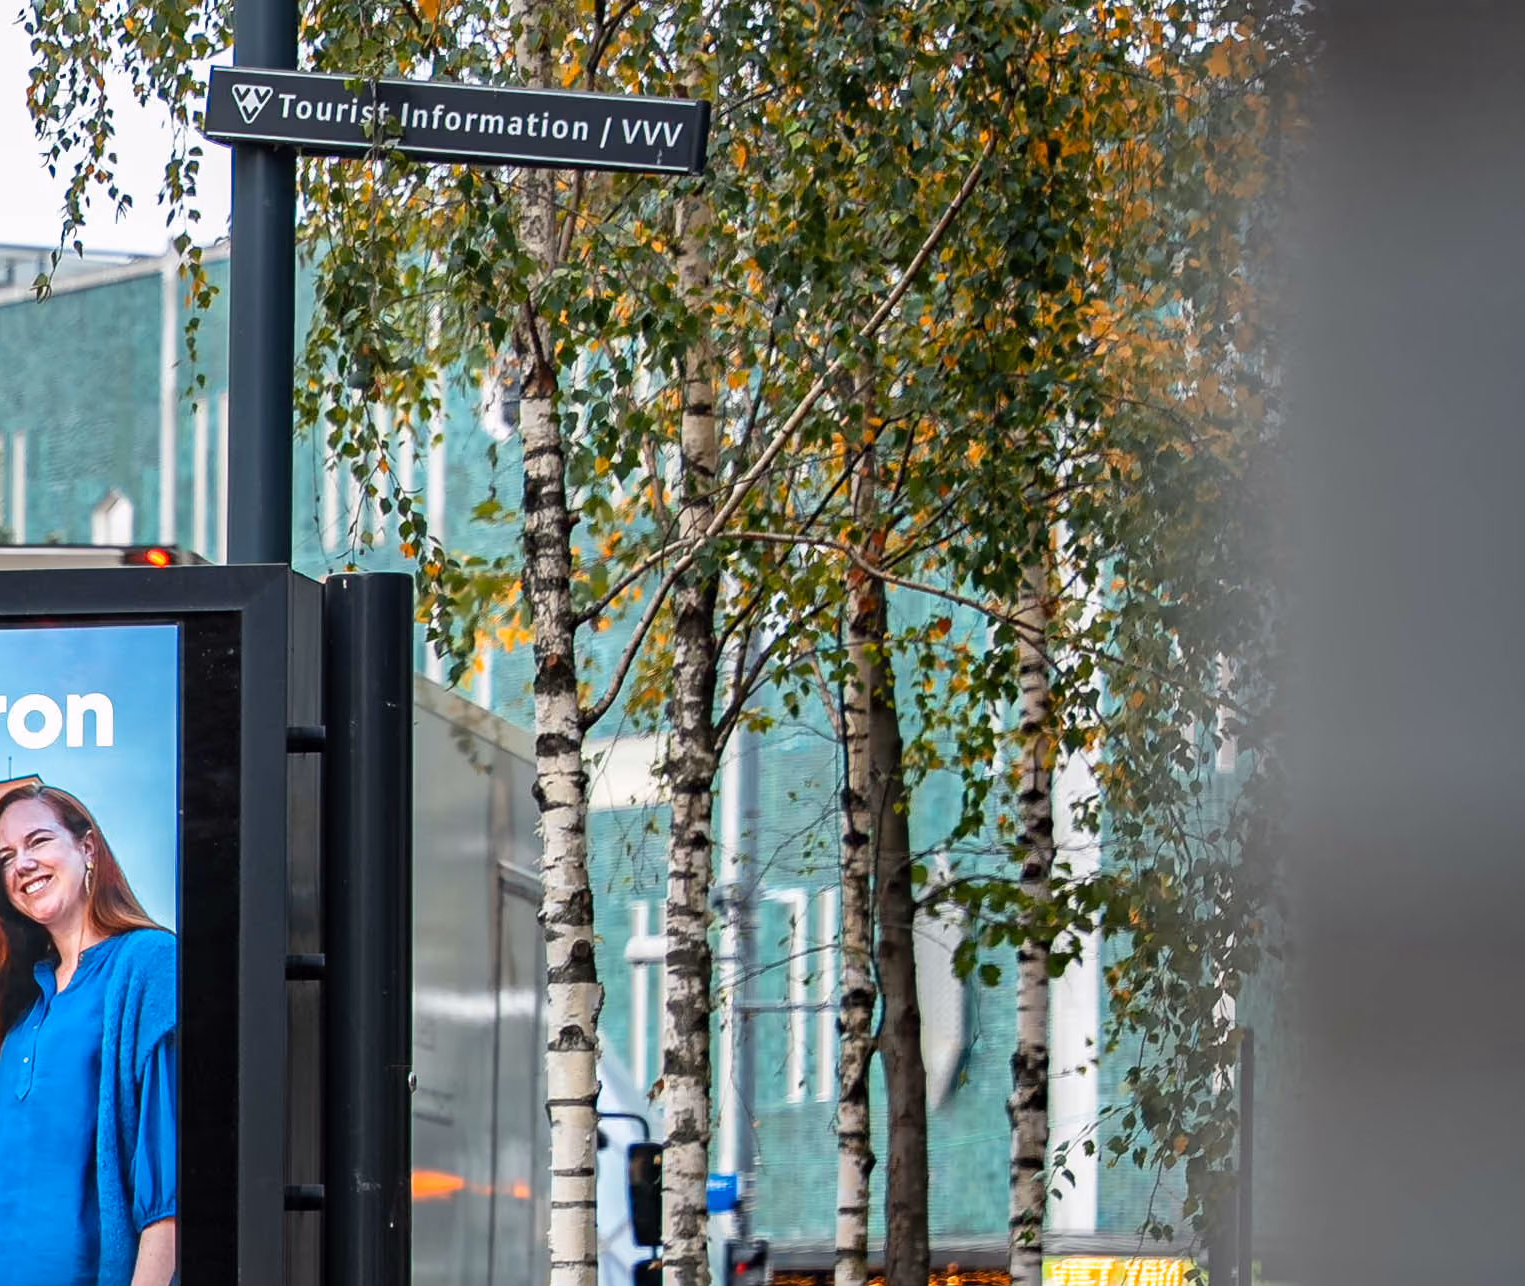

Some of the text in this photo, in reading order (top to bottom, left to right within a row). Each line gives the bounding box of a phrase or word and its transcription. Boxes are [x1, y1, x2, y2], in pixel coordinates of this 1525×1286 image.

[279, 94, 683, 149] Tourist Information / VVV
